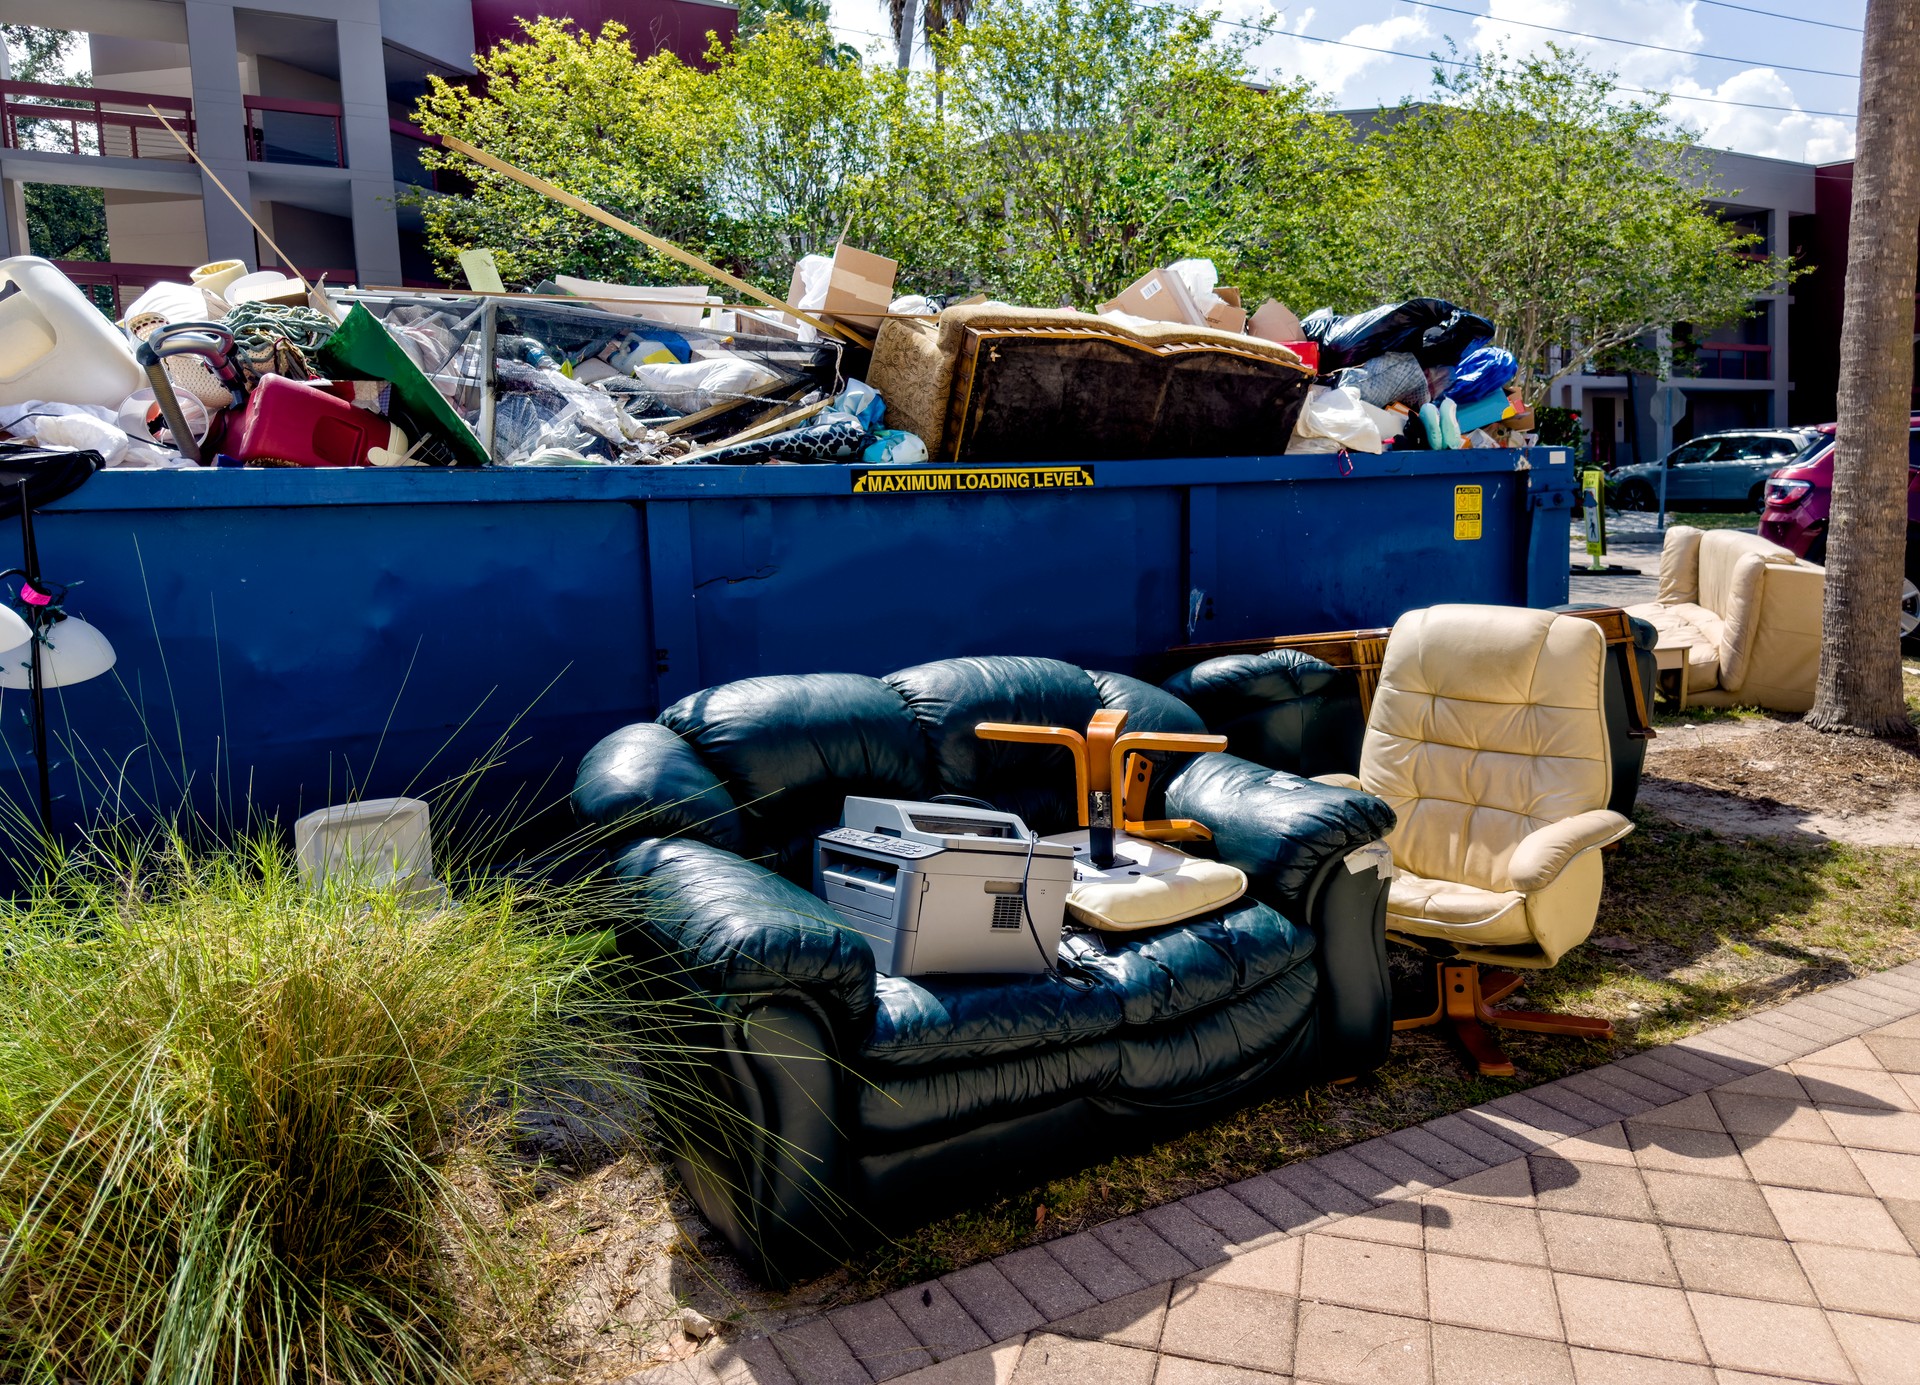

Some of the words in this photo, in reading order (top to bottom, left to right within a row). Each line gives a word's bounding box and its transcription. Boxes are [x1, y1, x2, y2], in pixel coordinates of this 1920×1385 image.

[867, 475, 951, 493] MAXIMUM
[956, 473, 1029, 490] LOADING
[1034, 472, 1083, 487] LEVEL
